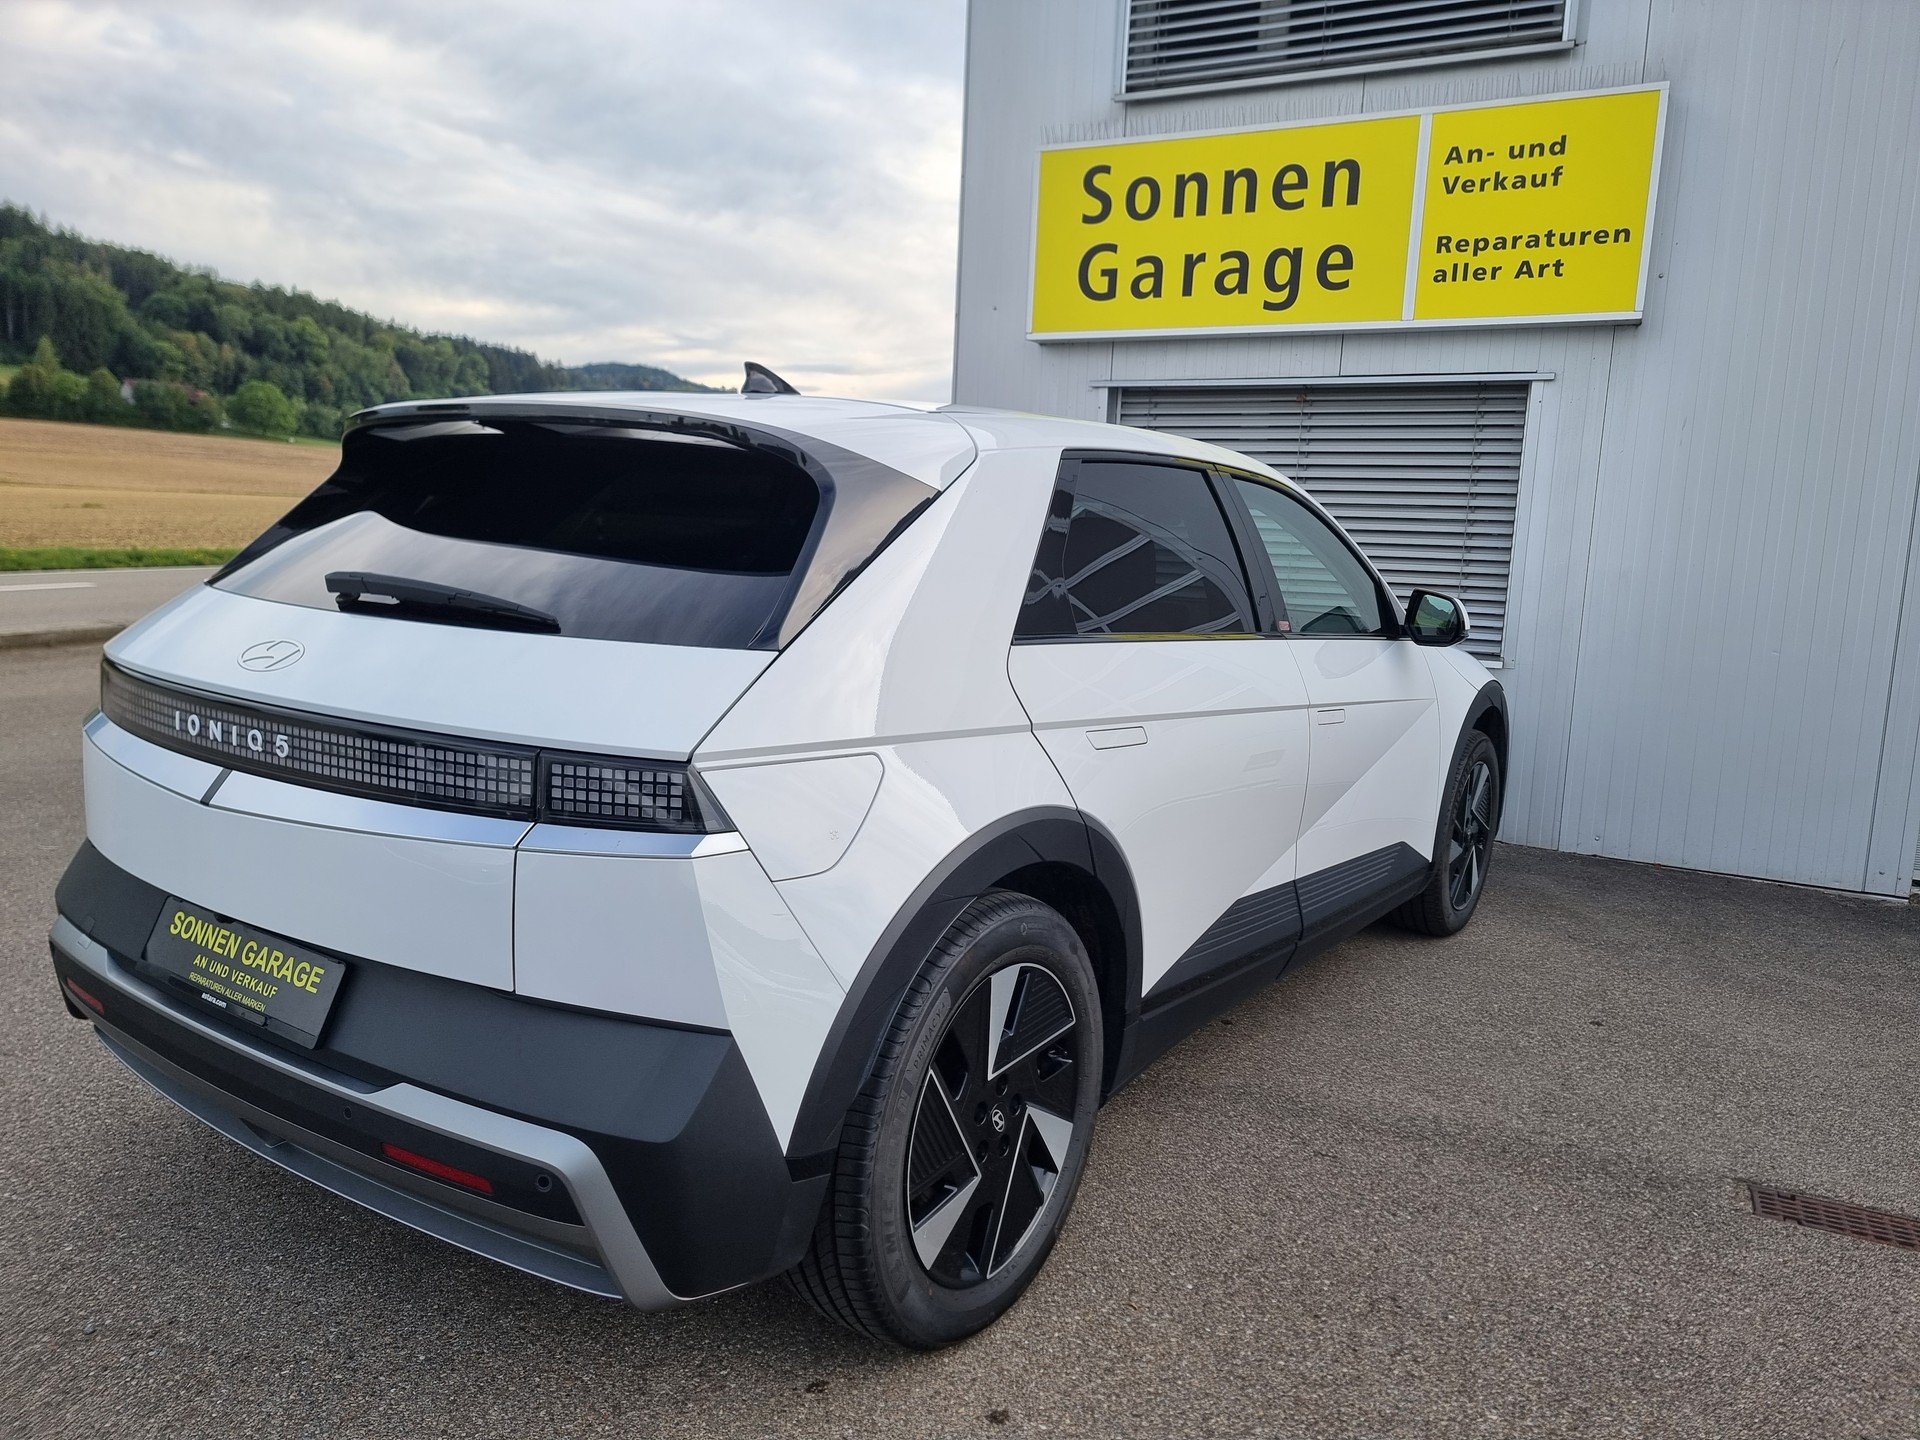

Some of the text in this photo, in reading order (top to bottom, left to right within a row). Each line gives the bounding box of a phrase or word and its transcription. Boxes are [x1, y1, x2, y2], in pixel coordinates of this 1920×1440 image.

[1443, 134, 1567, 166] An- und
[1081, 158, 1361, 225] Sonnen
[1442, 165, 1564, 195] Verkauf
[1435, 227, 1631, 258] Reparaturen
[1077, 242, 1354, 312] Garage
[1432, 258, 1565, 284] aller Art
[174, 710, 290, 759] IONIQ 5
[169, 911, 325, 994] SONNEN GARAGE
[189, 971, 267, 1012] REPARATUREN ALLER MARKEN
[193, 954, 278, 998] AN UND VERKAUF
[201, 992, 227, 1009] astara.com
